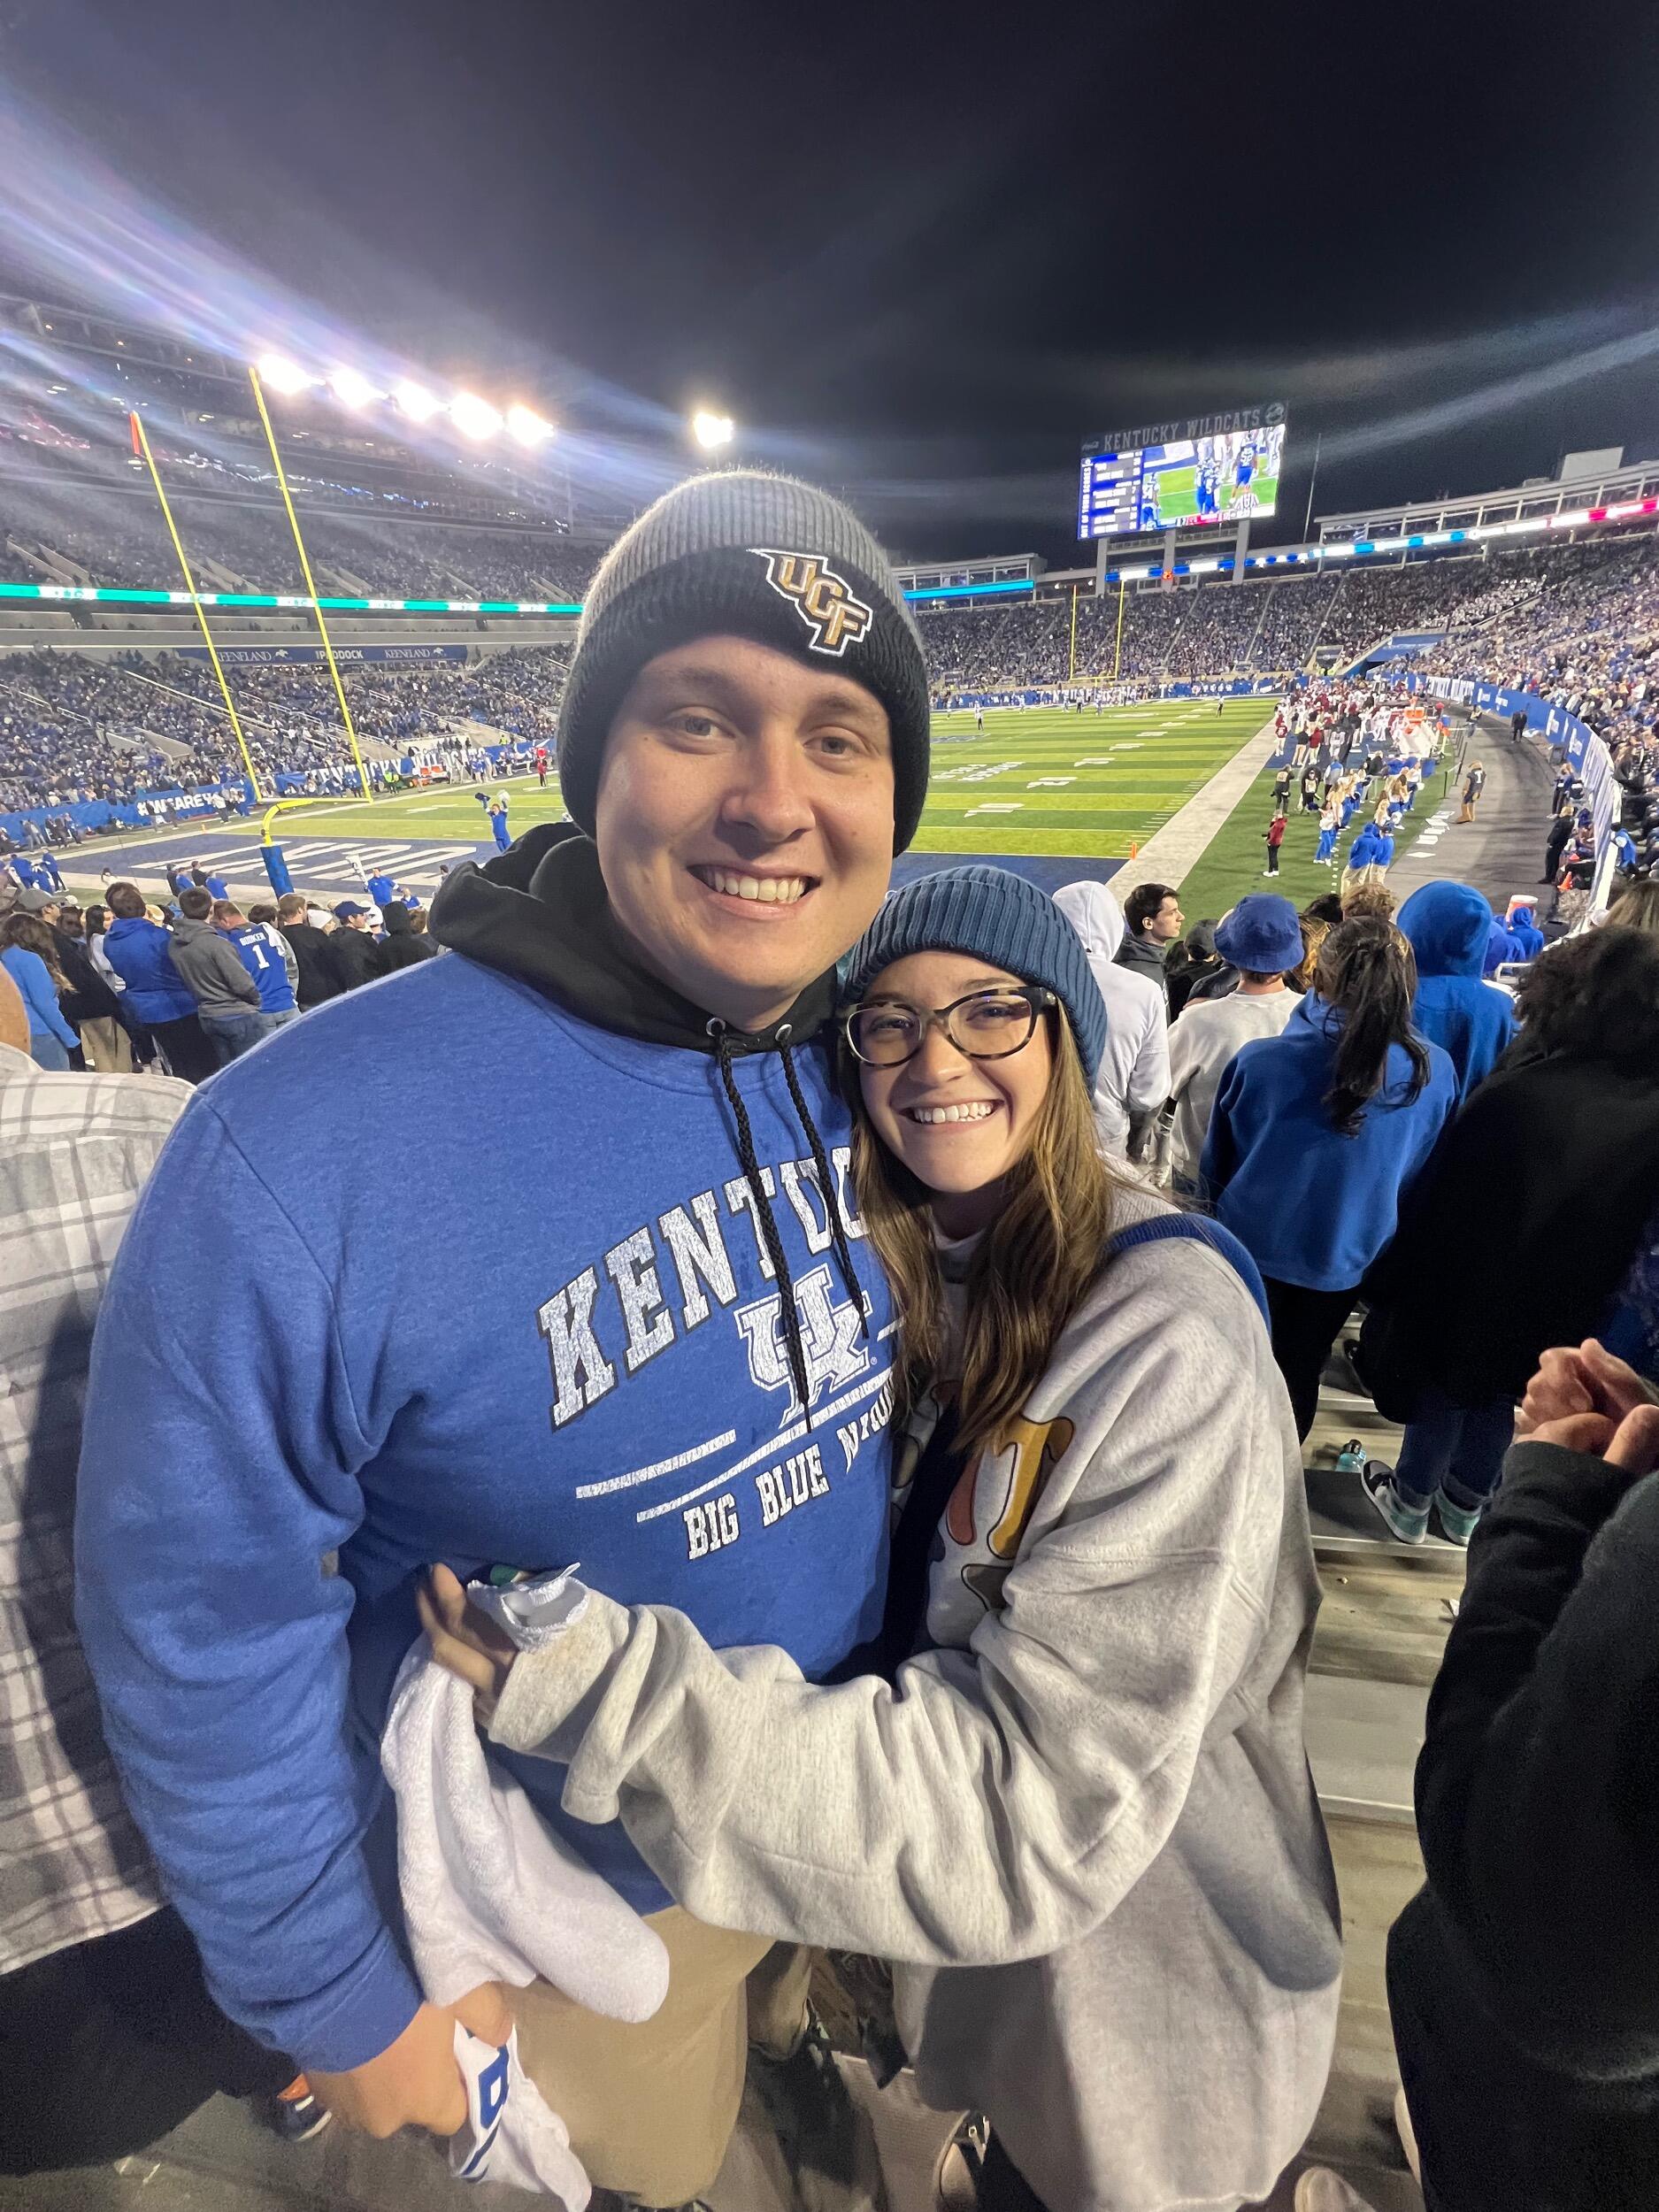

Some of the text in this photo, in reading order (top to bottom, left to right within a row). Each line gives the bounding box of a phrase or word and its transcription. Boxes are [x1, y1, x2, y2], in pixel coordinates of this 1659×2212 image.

[1104, 409, 1261, 452] KENTUCKY WILDCATS
[778, 555, 868, 646] UCF
[219, 650, 272, 662] EENELAND
[319, 649, 364, 660] PDDOCK
[384, 649, 430, 658] KEENELAND
[1474, 770, 1483, 784] 1
[252, 944, 270, 970] 1
[682, 1493, 741, 1561] BIG
[755, 1442, 831, 1528] BLUE
